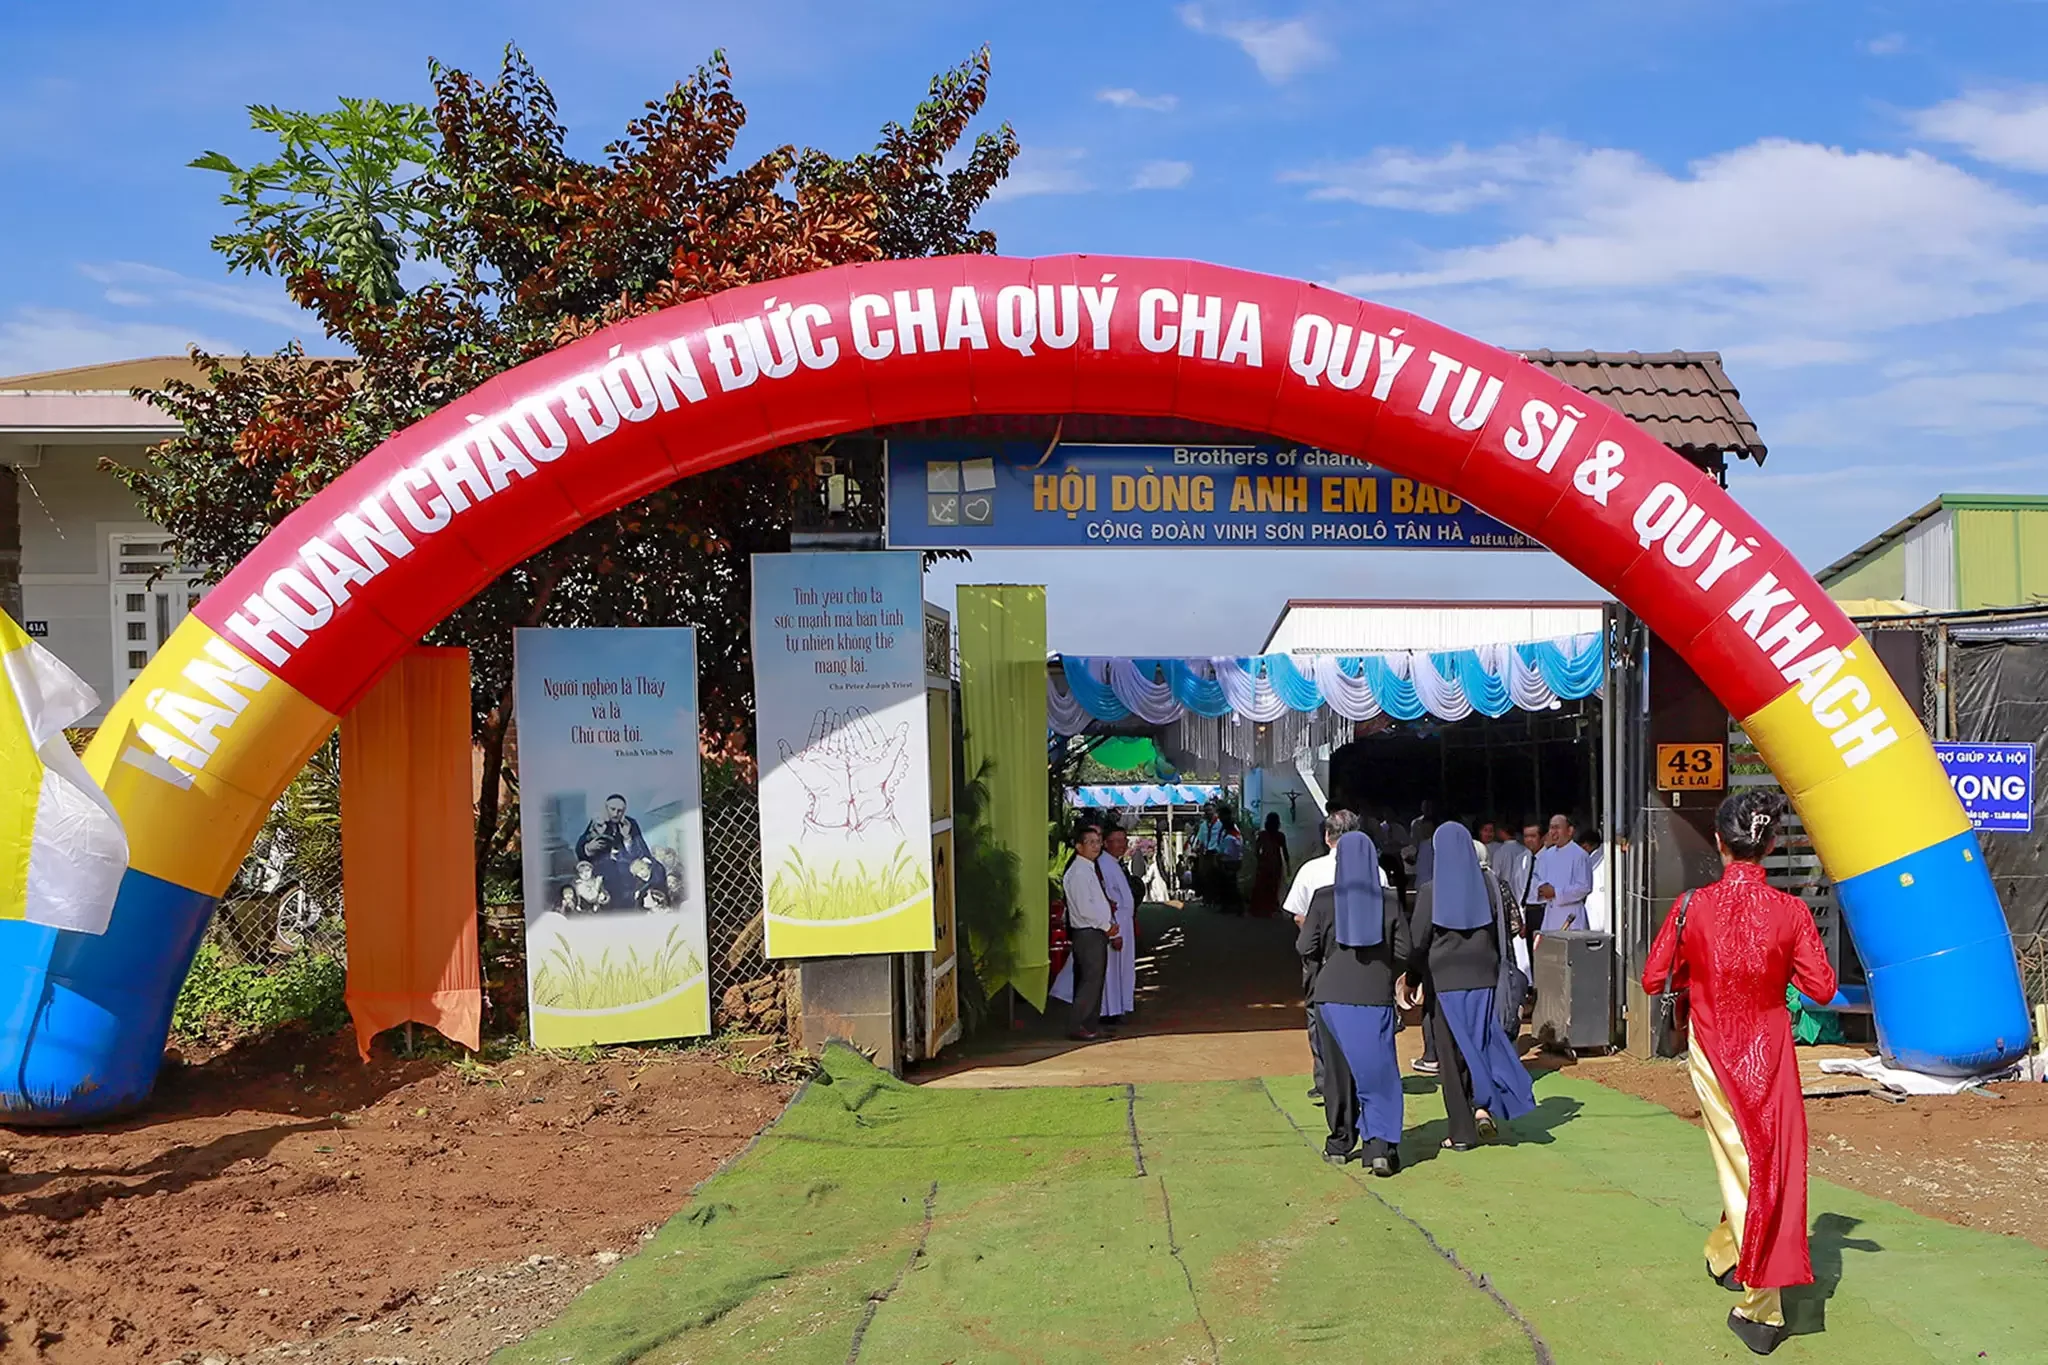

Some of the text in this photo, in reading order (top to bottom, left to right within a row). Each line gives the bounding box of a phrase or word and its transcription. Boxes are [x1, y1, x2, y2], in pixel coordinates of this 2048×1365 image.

[1173, 448, 1269, 466] Brothers
[1275, 448, 1297, 466] of
[1033, 465, 1096, 519] HỘI
[1111, 465, 1214, 512] DÒNG
[1230, 475, 1308, 513] ANH
[1321, 476, 1377, 513] EM
[224, 496, 416, 668] HOAN
[390, 396, 569, 534] CHÀO
[559, 337, 708, 445] ĐÓN
[703, 296, 840, 392] ĐỨC
[849, 285, 989, 361] CHA
[996, 273, 1120, 358] QUÝ
[1138, 287, 1263, 368] CHA
[1288, 313, 1415, 402] QUÝ
[1417, 350, 1504, 432] TU
[1503, 398, 1587, 474] SĨ
[1573, 440, 1626, 507] &
[1632, 481, 1762, 592] QUÝ
[1727, 570, 1899, 769] KHÁCH
[1086, 519, 1464, 542] CỘNG ĐOÀN VINH SƠN PHAOLÔ TÂN HÀ
[1470, 535, 1480, 545] 43
[846, 586, 867, 604] cho
[870, 586, 883, 604] ta
[28, 623, 46, 631] 41A
[774, 613, 794, 628] sức
[798, 610, 831, 630] mạnh
[815, 655, 868, 677] mang lại.
[582, 676, 618, 700] nghèo
[621, 676, 632, 695] là
[609, 700, 621, 719] là
[1668, 749, 1713, 773] 43
[1936, 750, 2027, 765] RỢ GIÚP XÃ HỘI
[1671, 774, 1709, 785] LÊ LAI
